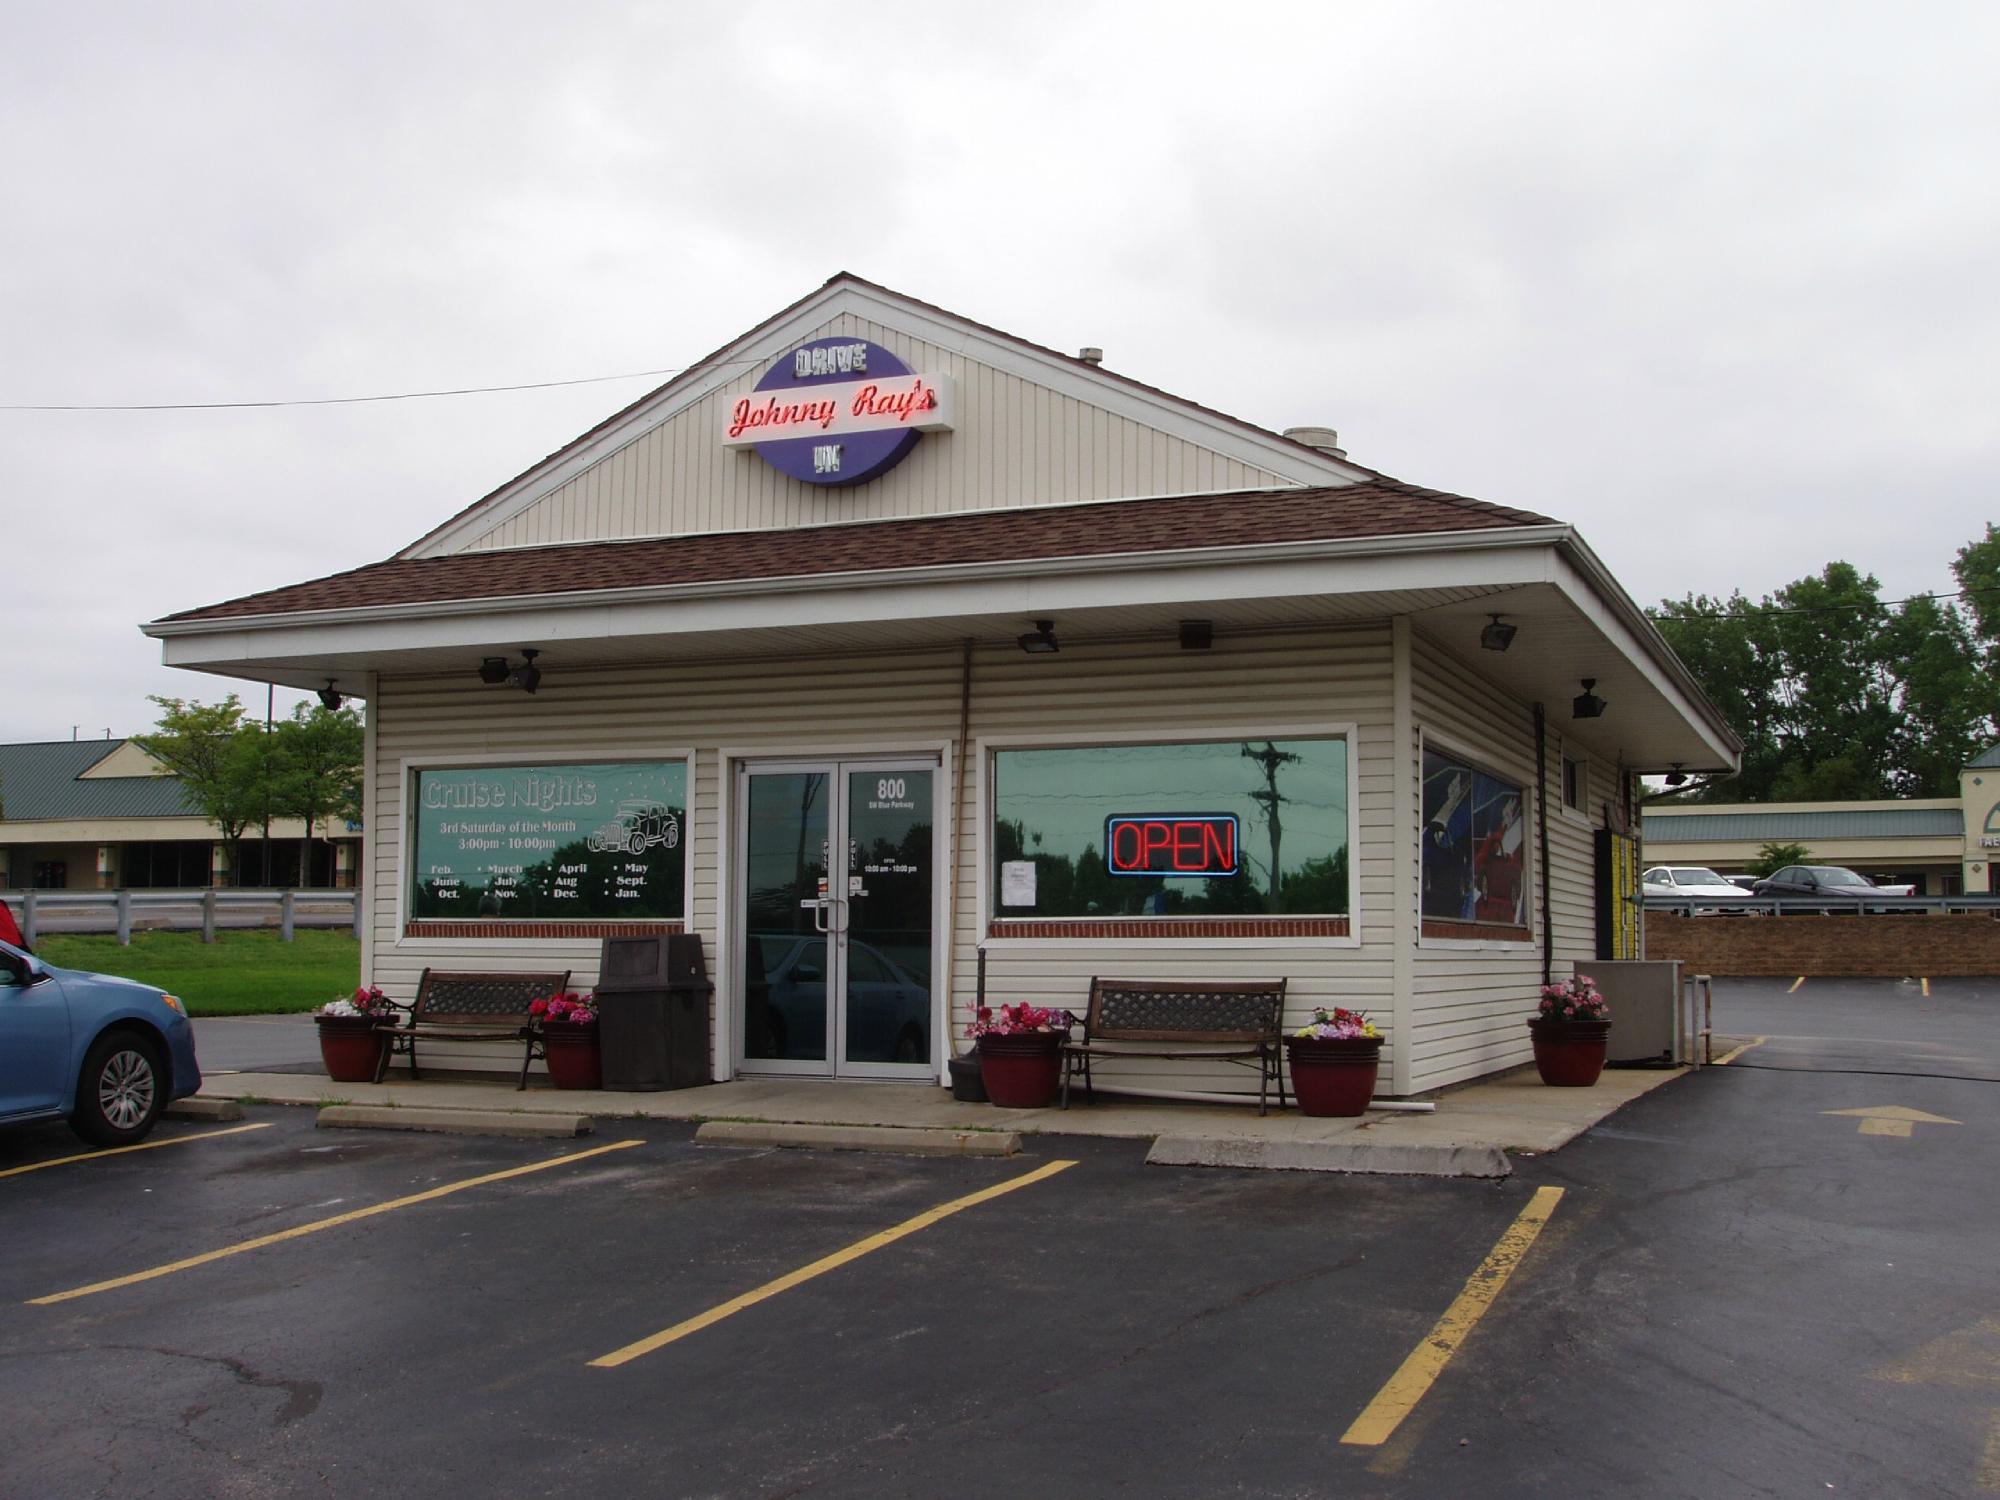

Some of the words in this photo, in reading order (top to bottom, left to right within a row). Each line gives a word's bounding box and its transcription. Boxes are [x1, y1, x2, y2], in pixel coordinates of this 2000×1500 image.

[795, 344, 867, 377] DRIVE
[729, 397, 836, 438] Johnny
[852, 379, 936, 422] Ray's
[423, 777, 506, 809] Cruise
[511, 775, 597, 812] Nights
[878, 779, 905, 798] 800
[440, 822, 459, 834] 3rd
[461, 821, 507, 834] Saturday
[509, 821, 521, 833] of
[522, 821, 540, 832] the
[542, 820, 576, 832] Month
[458, 837, 499, 850] 3:00pm
[508, 837, 556, 850] 10:00pm
[1112, 821, 1233, 871] OPEN
[431, 865, 453, 874] Feb.
[488, 865, 523, 874] March
[558, 864, 587, 874] April
[624, 864, 649, 874] May
[432, 879, 460, 887] June
[494, 879, 518, 888] July
[555, 878, 578, 888] Aug
[616, 877, 648, 887] Sept.
[438, 889, 460, 899] Oct.
[494, 889, 518, 898] Nov.
[553, 889, 579, 898] Dec.
[615, 889, 640, 898] Jan.
